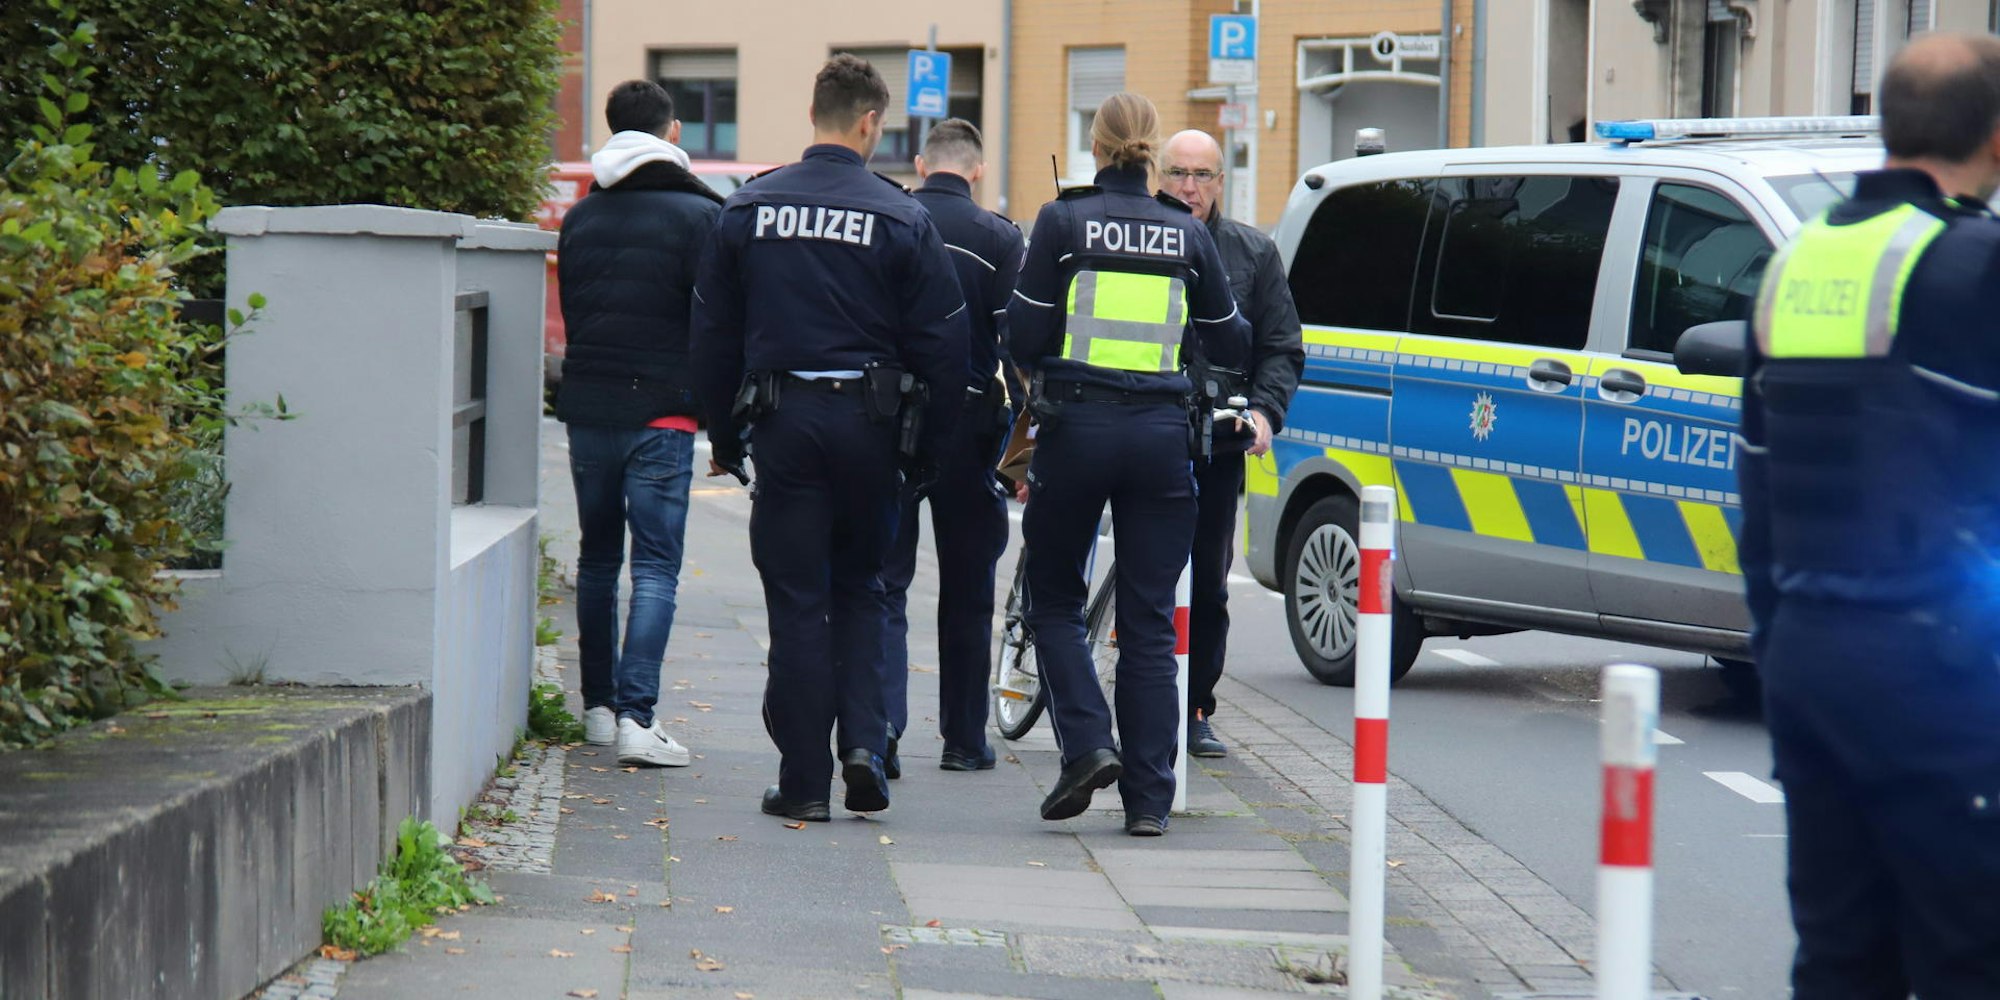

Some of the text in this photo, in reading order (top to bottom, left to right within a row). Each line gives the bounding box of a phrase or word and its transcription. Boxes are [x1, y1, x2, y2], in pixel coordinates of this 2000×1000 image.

[1220, 21, 1246, 56] P
[914, 55, 934, 81] P
[755, 205, 875, 246] POLIZEI
[1085, 220, 1185, 257] POLIZEI
[1778, 278, 1862, 316] POLIZEI
[1621, 417, 1737, 470] POLIZEI
